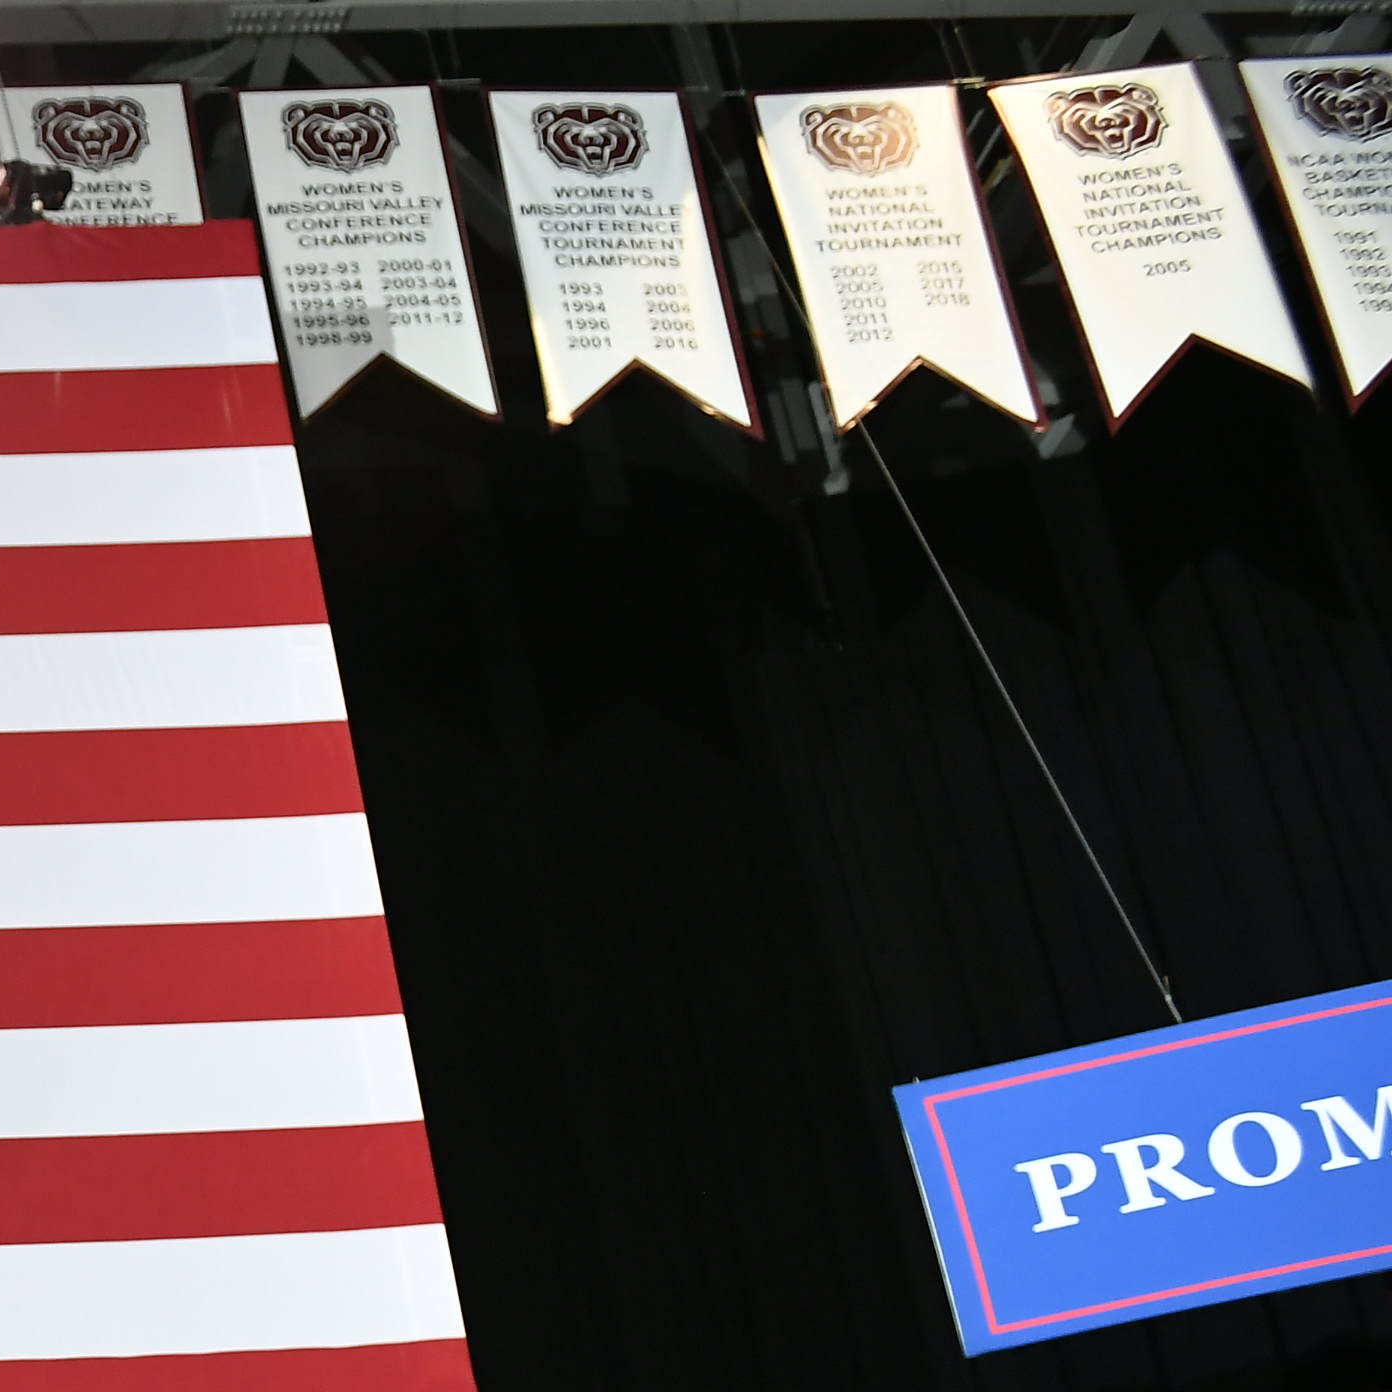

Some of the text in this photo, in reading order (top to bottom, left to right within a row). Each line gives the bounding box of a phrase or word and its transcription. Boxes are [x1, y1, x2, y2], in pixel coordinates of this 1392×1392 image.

[1079, 162, 1183, 186] WOMEN'S
[302, 181, 403, 196] WOMEN'S
[554, 186, 654, 199] WOMEN'S
[826, 185, 928, 200] WOMEN'S
[1083, 181, 1192, 203] NATIONAL
[267, 196, 443, 215] MISSOURI VALLEY
[521, 203, 615, 216] MISSOURI
[828, 202, 935, 216] NATIONAL
[1084, 195, 1201, 220] INVITATION
[286, 213, 432, 230] CONFERENCE
[539, 220, 681, 233] CONFERENCE
[828, 218, 943, 234] INVITATION
[1075, 207, 1224, 238] TOURNAMENT
[299, 230, 426, 247] CHAMPIONS
[542, 237, 685, 249] TOURNAMENT
[815, 233, 962, 252] TOURNAMENT
[1091, 227, 1223, 254] CHAMPIONS
[379, 258, 452, 273] 2000-01
[555, 254, 681, 267] CHAMPIONS
[918, 260, 962, 274] 2015
[831, 265, 877, 278] 2002
[1143, 259, 1192, 277] 2005
[921, 277, 964, 289] 2017
[563, 300, 606, 312] 1994
[841, 297, 887, 310] 2010
[390, 312, 463, 325] 2011-12
[845, 313, 888, 326] 2011
[569, 336, 612, 348] 2001
[848, 329, 893, 343] 2012
